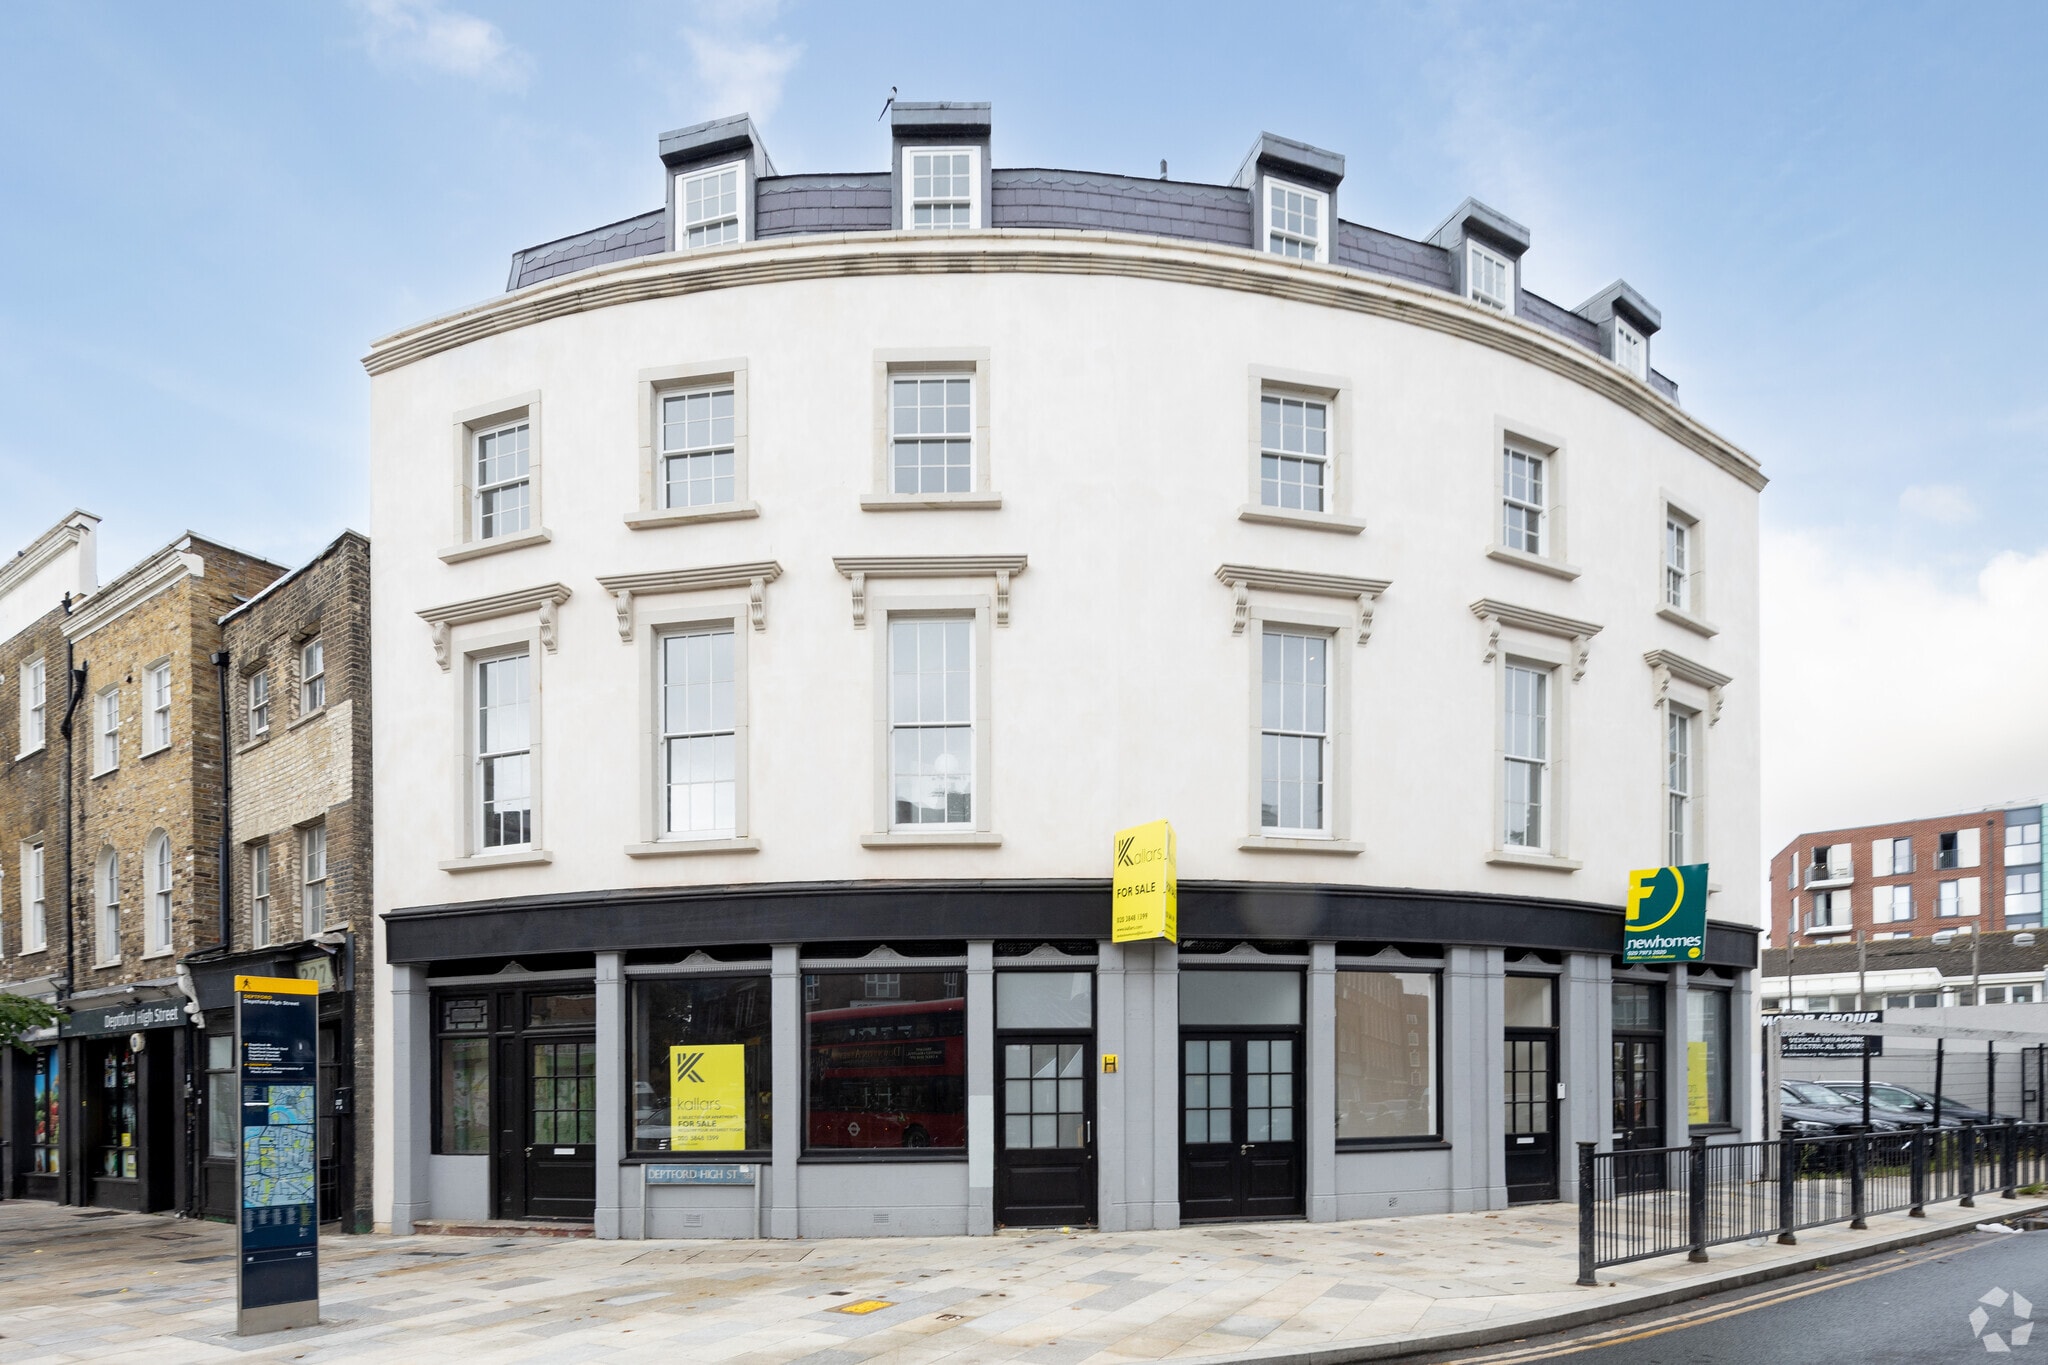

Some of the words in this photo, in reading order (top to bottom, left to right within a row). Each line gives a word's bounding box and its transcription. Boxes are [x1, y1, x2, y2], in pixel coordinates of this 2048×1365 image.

[1117, 886, 1133, 898] FOR
[1135, 882, 1156, 895] SALE
[1625, 934, 1702, 950] newhomes
[104, 1011, 136, 1029] Deptford
[136, 1009, 153, 1026] High
[154, 1006, 179, 1022] Street
[1104, 1056, 1116, 1073] H
[677, 1097, 721, 1111] kallars
[648, 1169, 696, 1179] DEPTFORD
[699, 1169, 723, 1178] HIGH
[726, 1169, 737, 1179] ST
